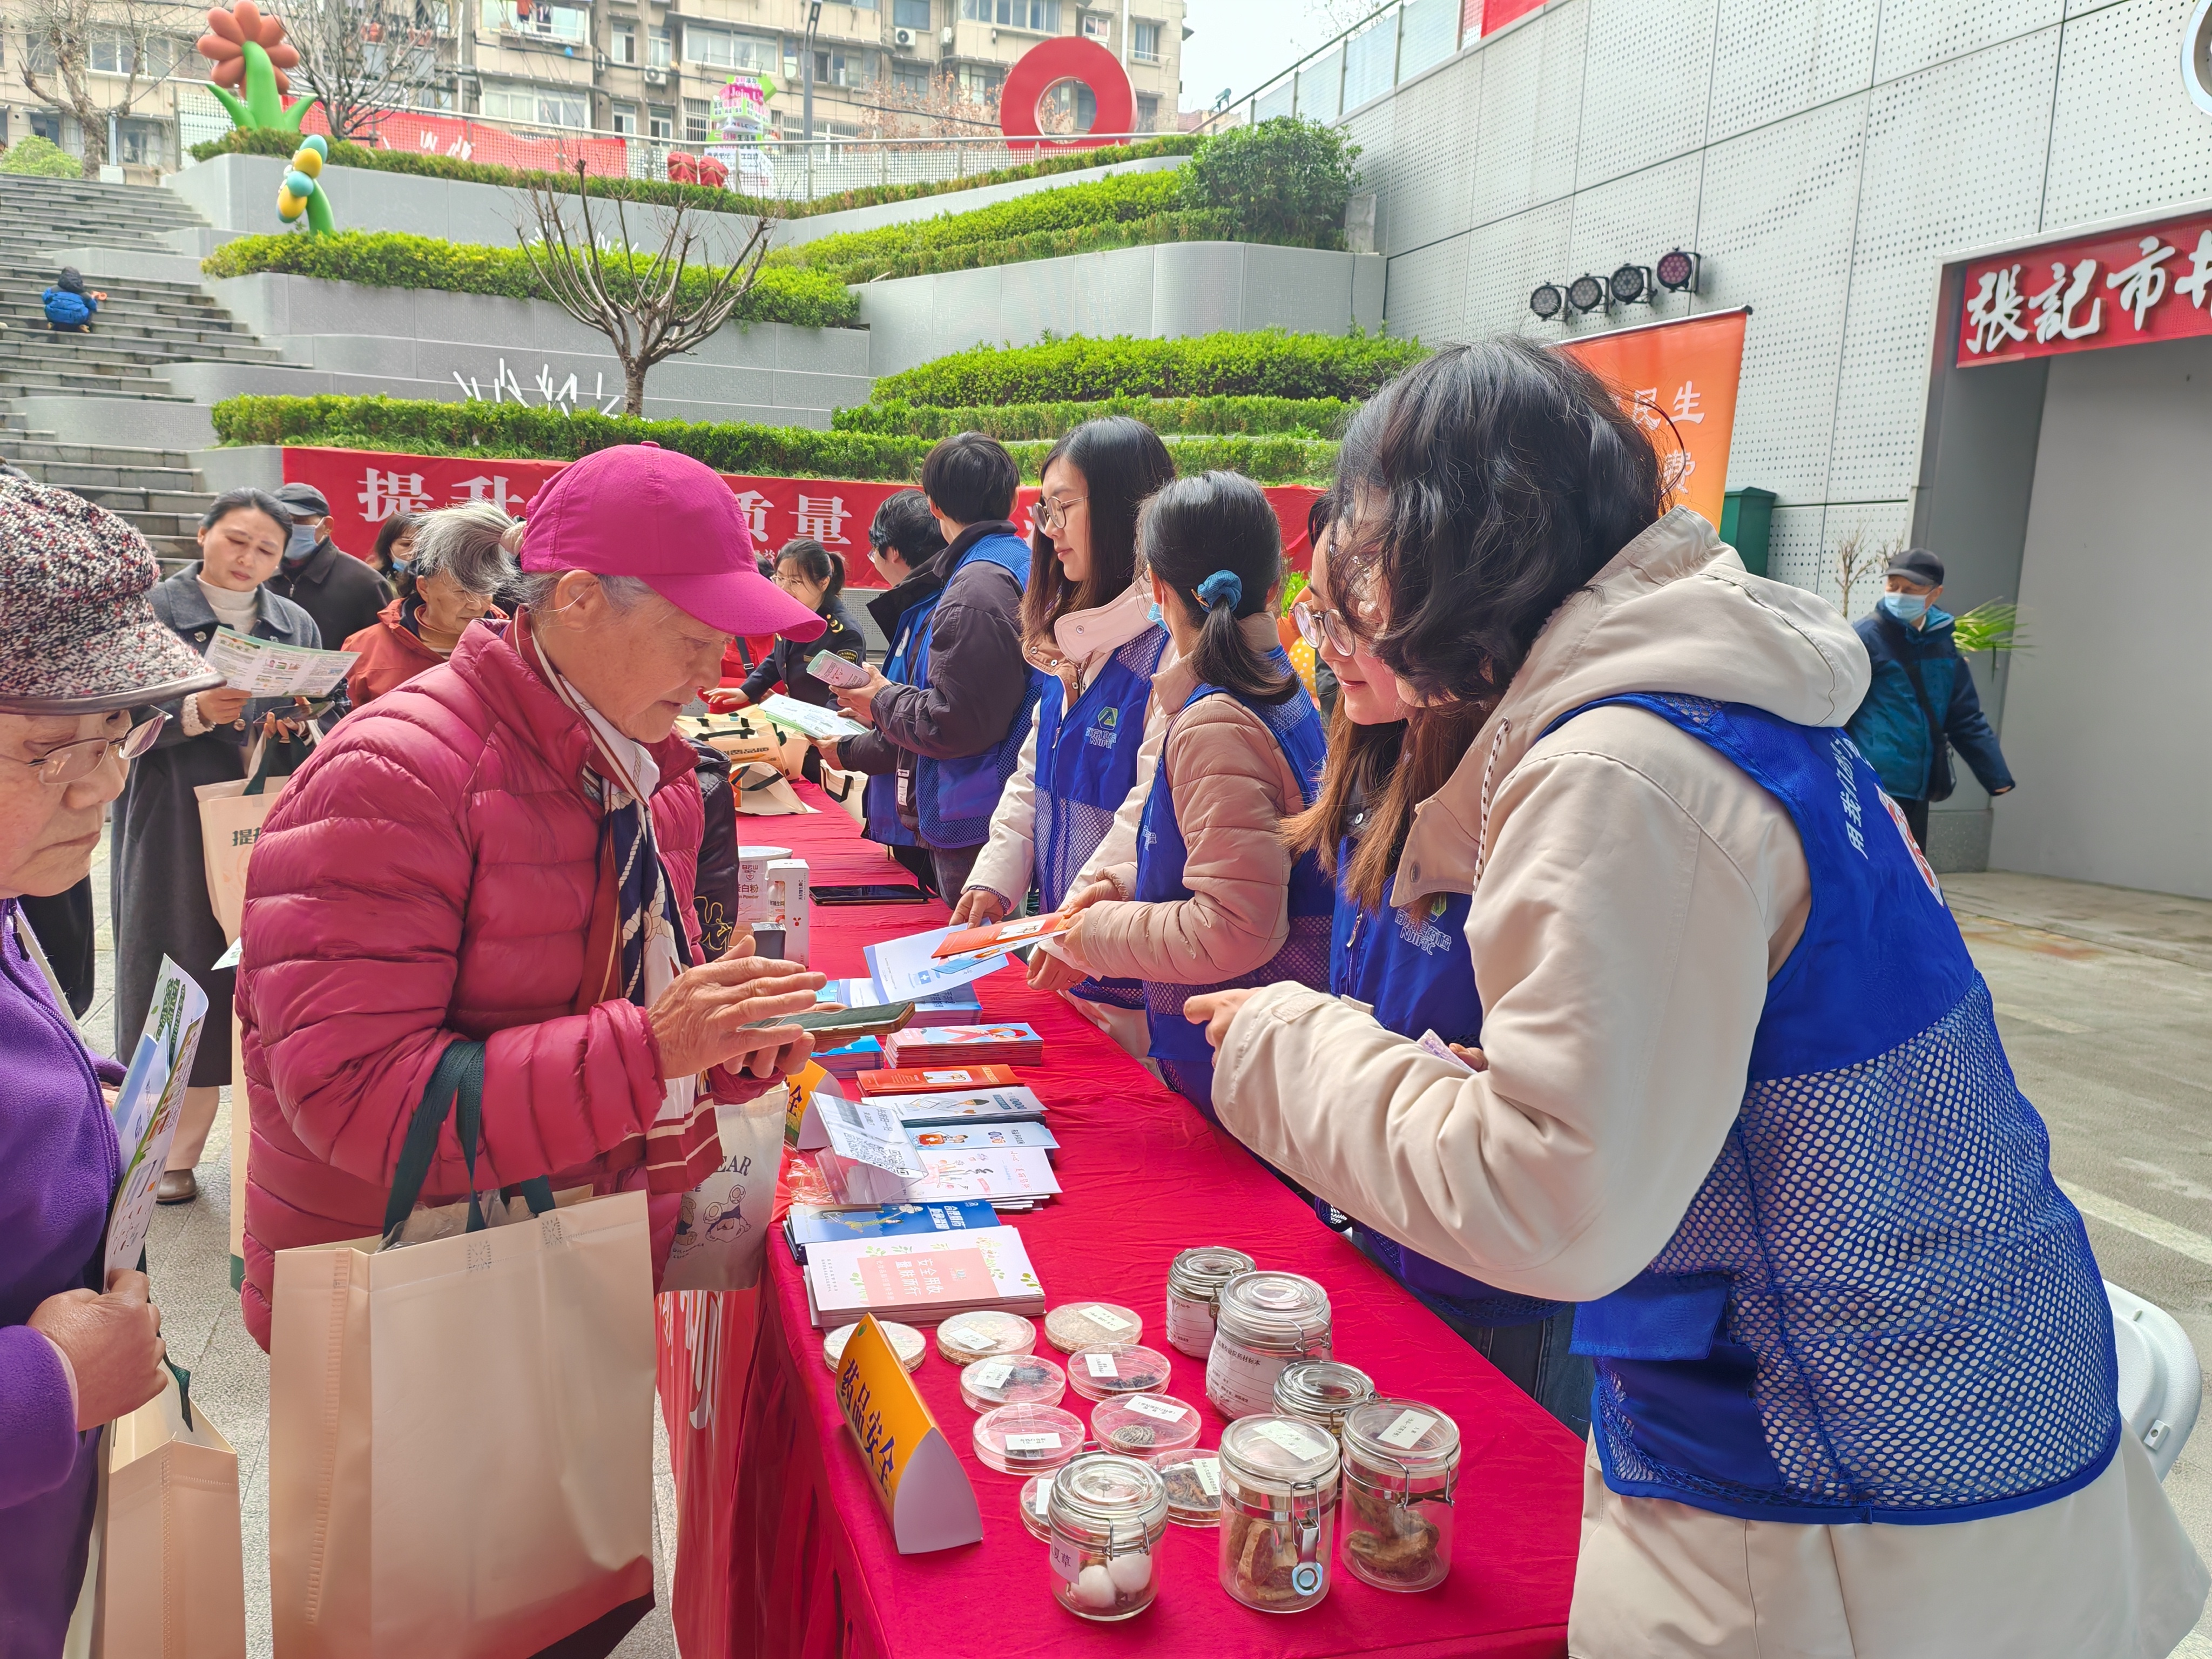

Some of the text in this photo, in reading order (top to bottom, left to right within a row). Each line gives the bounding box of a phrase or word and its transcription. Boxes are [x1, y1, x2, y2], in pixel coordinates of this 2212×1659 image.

[731, 86, 750, 99] Join
[1399, 927, 1437, 956] NJIFDC
[895, 1260, 921, 1297] 量肤而行
[916, 1257, 942, 1296] 安全用妆
[841, 1358, 895, 1498] 药品安全
